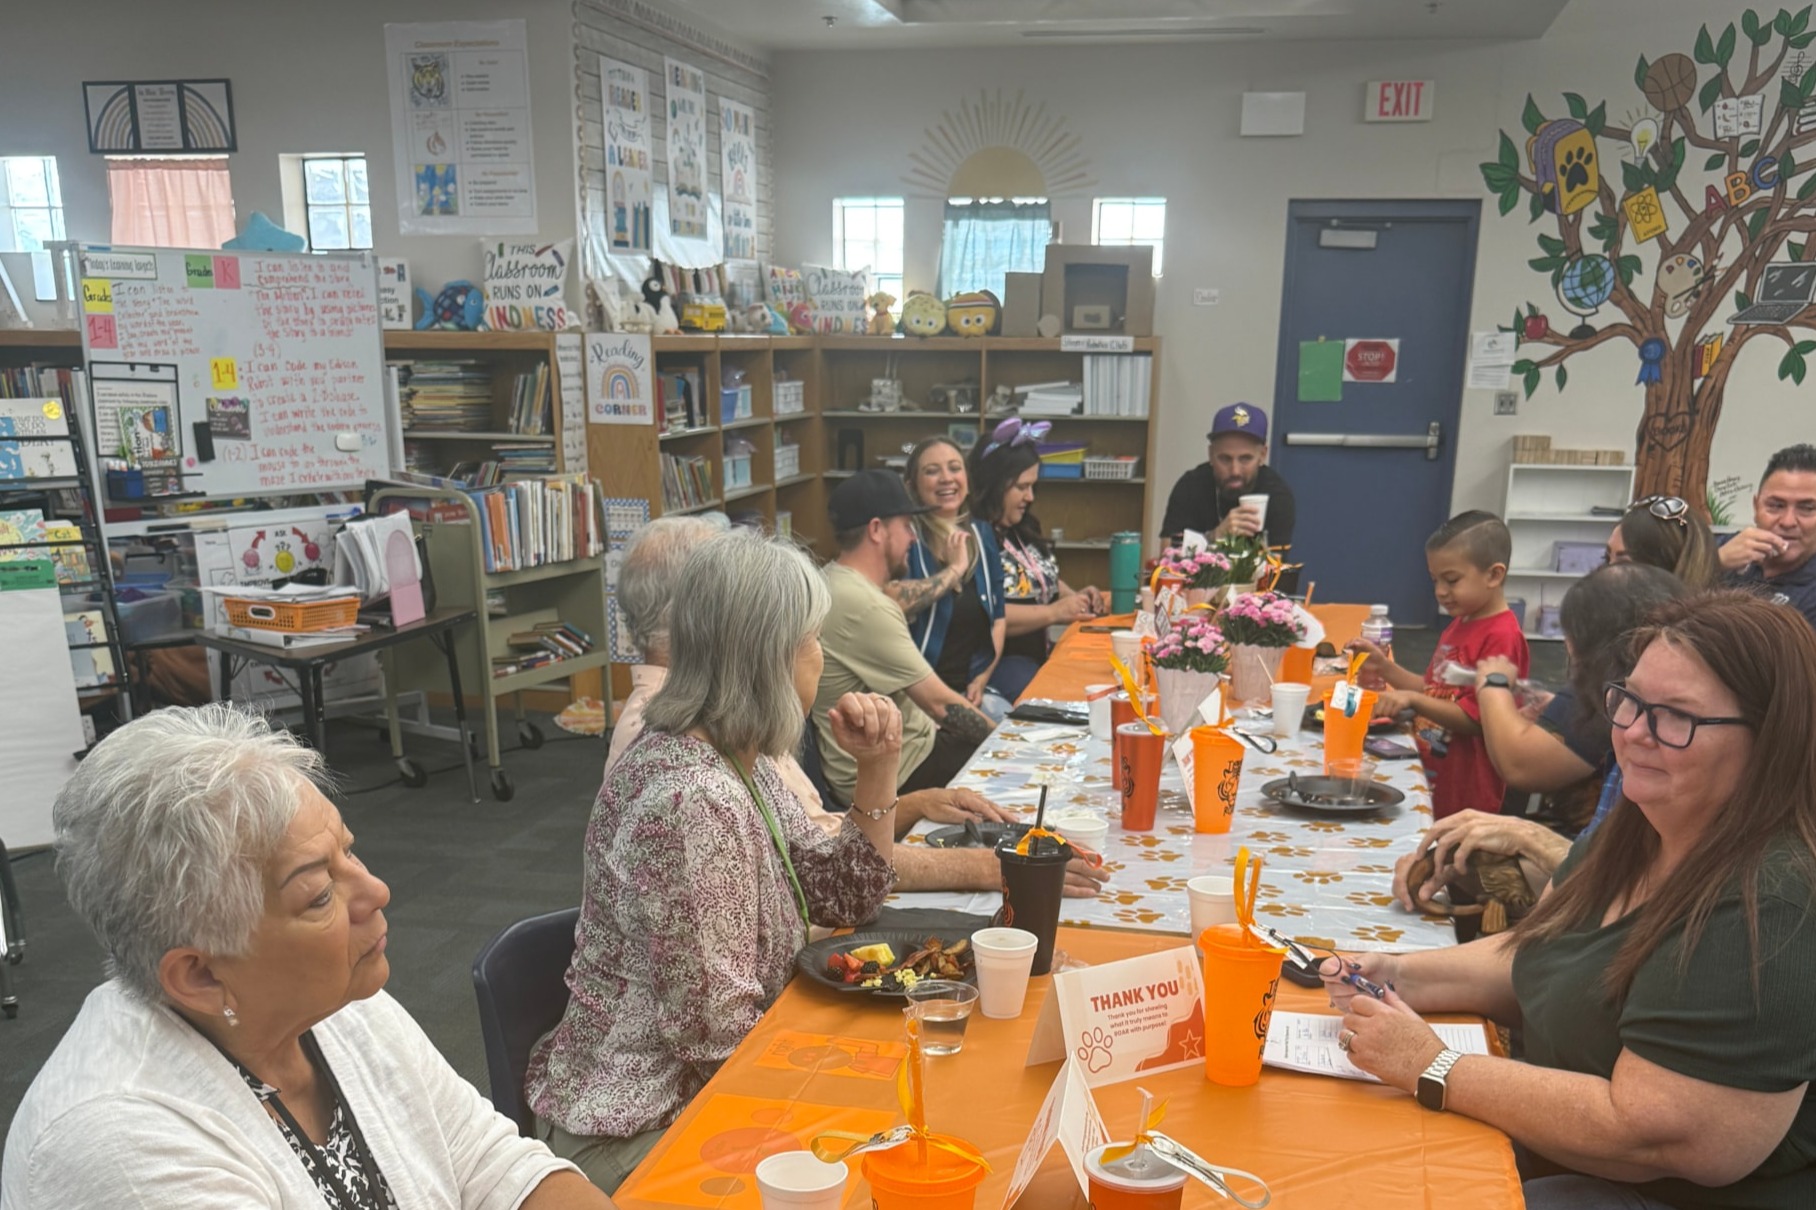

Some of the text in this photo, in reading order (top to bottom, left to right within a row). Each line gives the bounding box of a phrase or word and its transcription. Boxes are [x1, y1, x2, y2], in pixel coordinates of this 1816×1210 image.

[1378, 82, 1424, 117] EXIT
[510, 244, 536, 256] THIS
[221, 260, 234, 284] K
[483, 250, 563, 282] Classroom
[493, 284, 543, 300] RUNS ON
[88, 317, 114, 344] 1-4
[591, 340, 645, 369] Reading
[595, 404, 647, 416] CORNER
[1090, 980, 1179, 1013] THANK YOU
[1107, 1011, 1125, 1021] Thank
[1125, 1010, 1136, 1018] you
[1145, 1003, 1168, 1013] showing
[1110, 1020, 1124, 1029] what
[1130, 1016, 1142, 1026] truly
[1143, 1013, 1161, 1022] means
[1114, 1020, 1167, 1037] ROAR with purpose!
